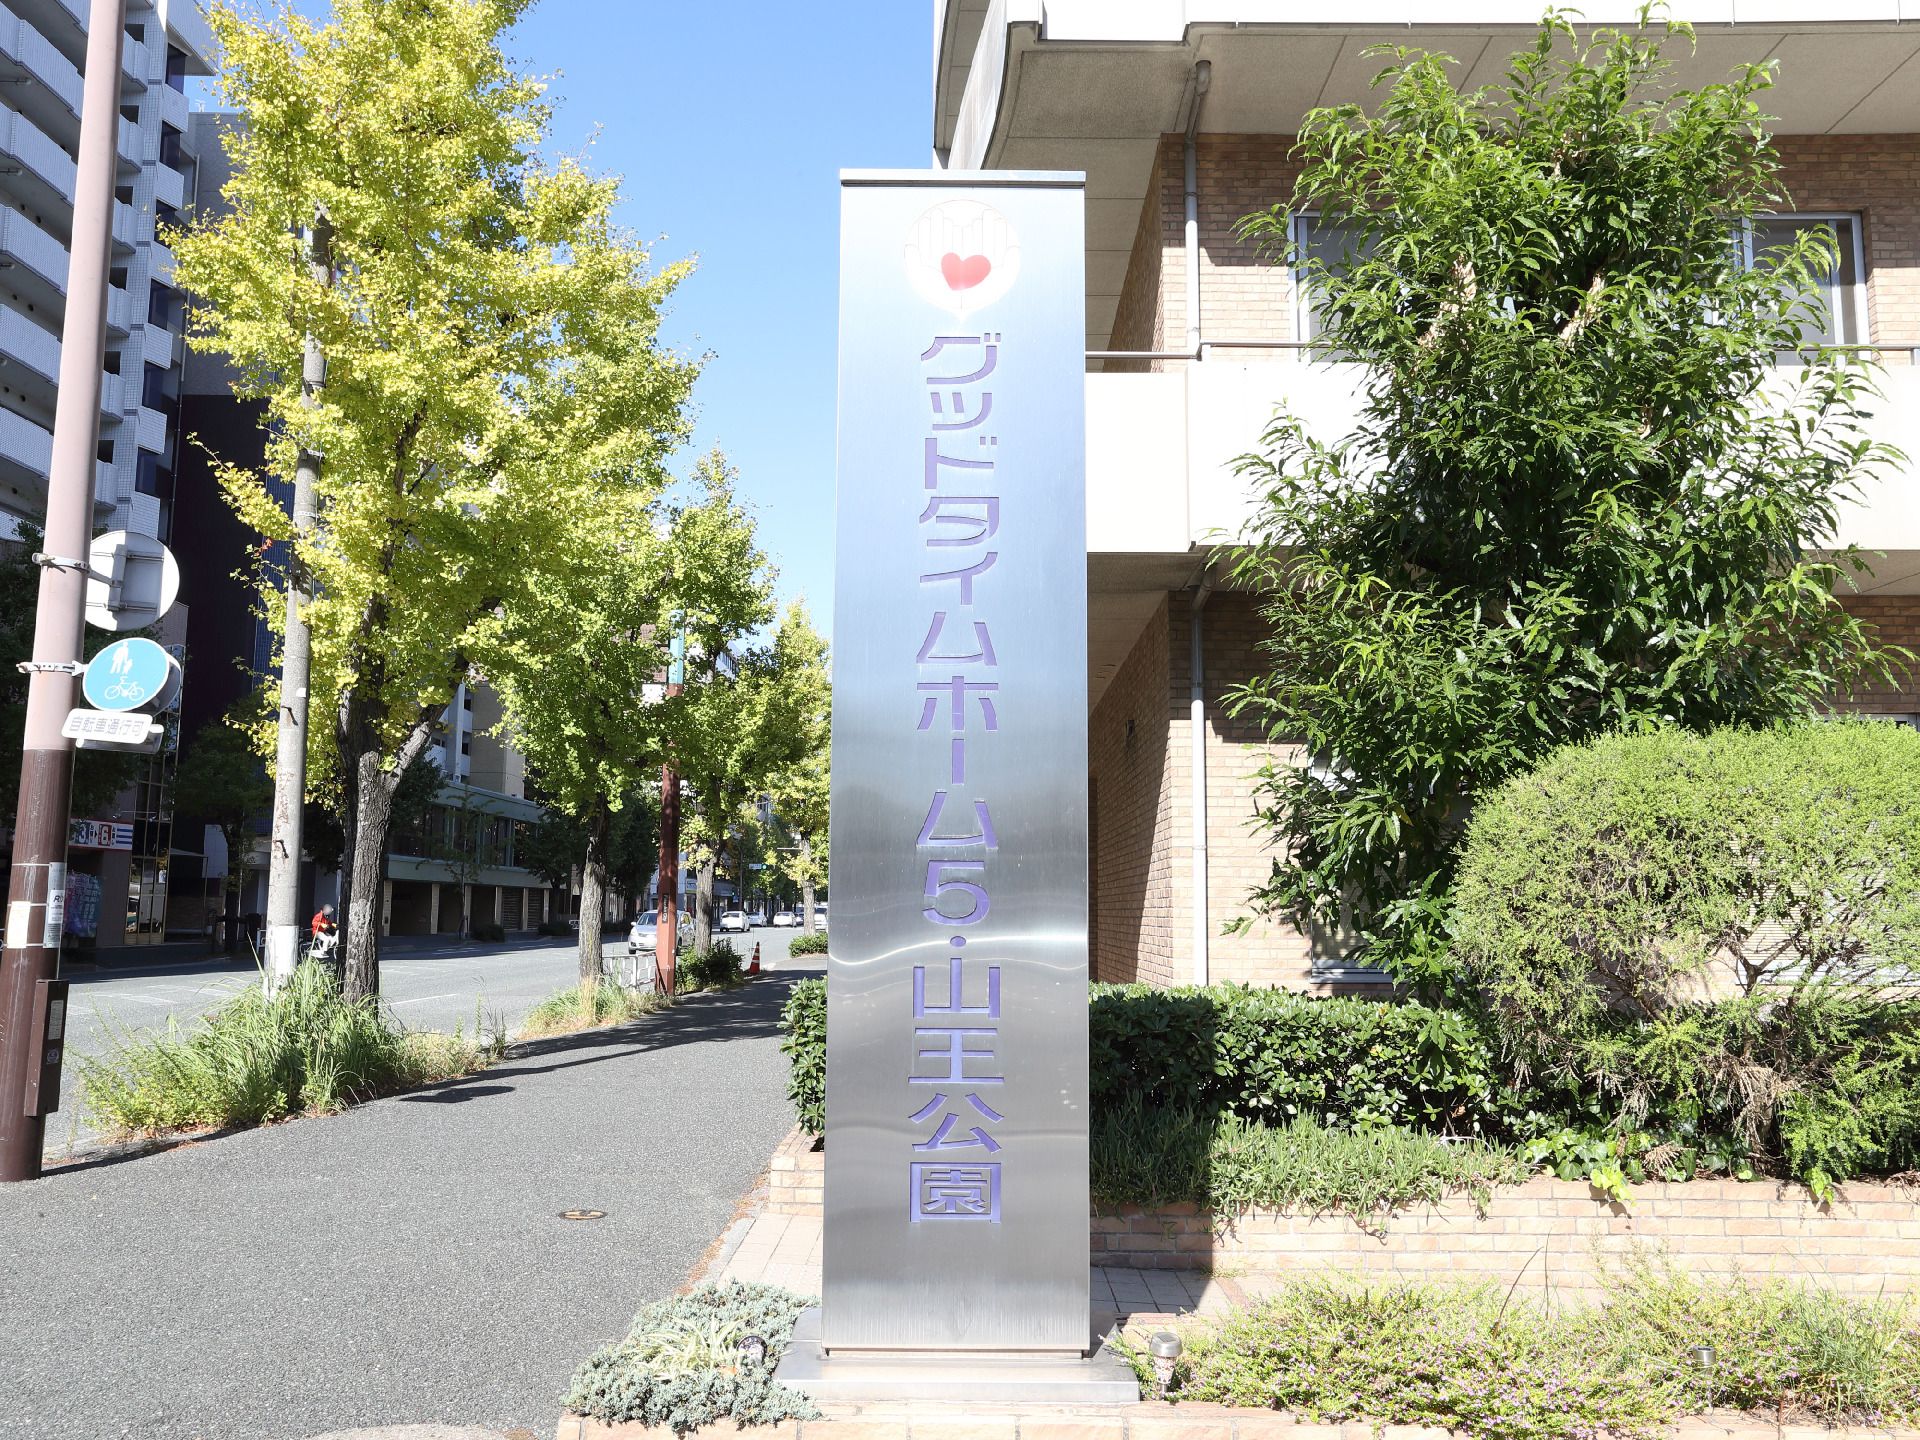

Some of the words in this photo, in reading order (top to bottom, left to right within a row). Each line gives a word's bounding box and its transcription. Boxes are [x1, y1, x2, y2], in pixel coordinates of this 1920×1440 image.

[69, 716, 145, 736] 自転車通行可
[908, 333, 1005, 1223] グッドタイムホーム5・山王公園
